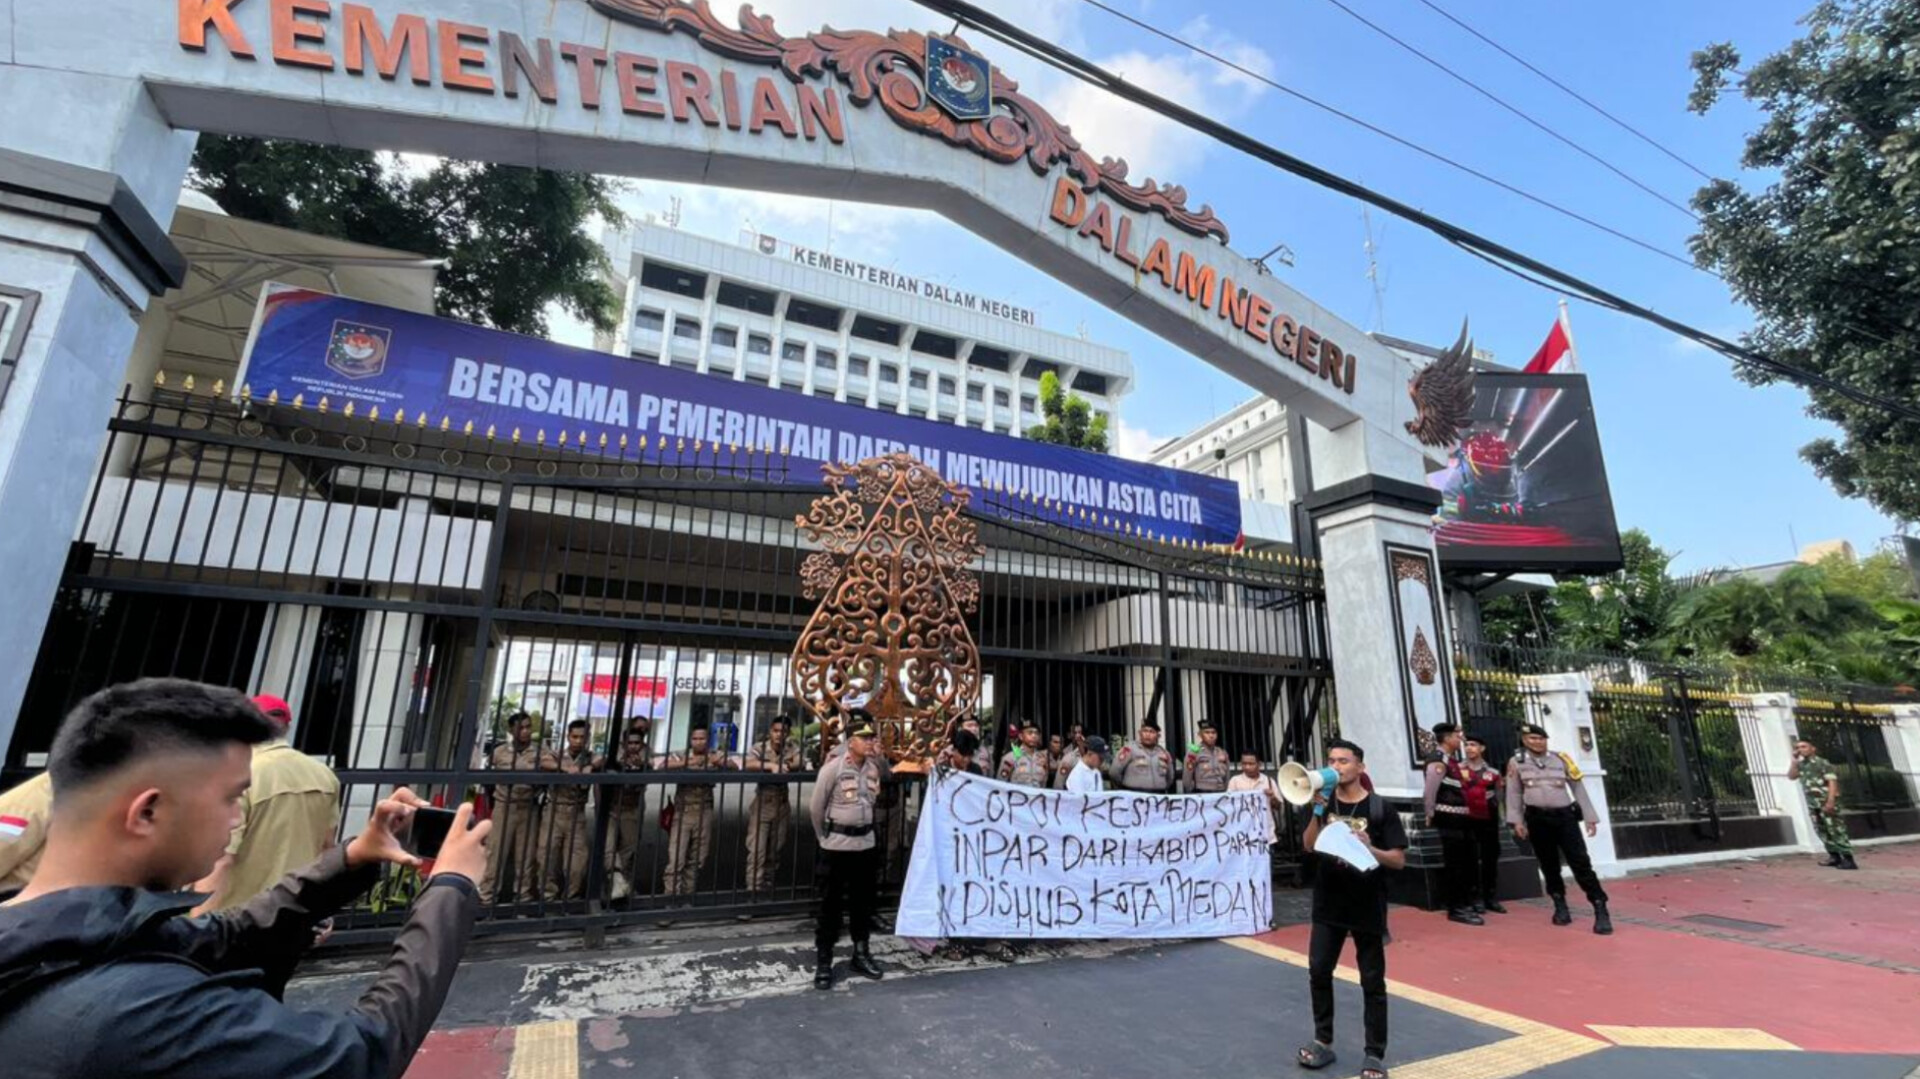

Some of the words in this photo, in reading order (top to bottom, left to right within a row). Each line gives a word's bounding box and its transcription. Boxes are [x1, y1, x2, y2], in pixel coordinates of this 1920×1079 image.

[178, 0, 844, 144] KEMENTERIAN
[1050, 177, 1218, 310] DALAM
[1219, 276, 1357, 394] NEGERI
[794, 247, 919, 294] KEMENTERIAN
[924, 282, 976, 310] DALAM
[980, 300, 1035, 326] NEGERI
[448, 357, 630, 428] BERSAMA
[636, 393, 831, 462] PEMERINTAH
[945, 453, 1105, 509] MEWUJUDKAN
[1108, 481, 1157, 518] ASTA
[1160, 490, 1203, 525] CITA
[1161, 869, 1268, 934] MEDAN
